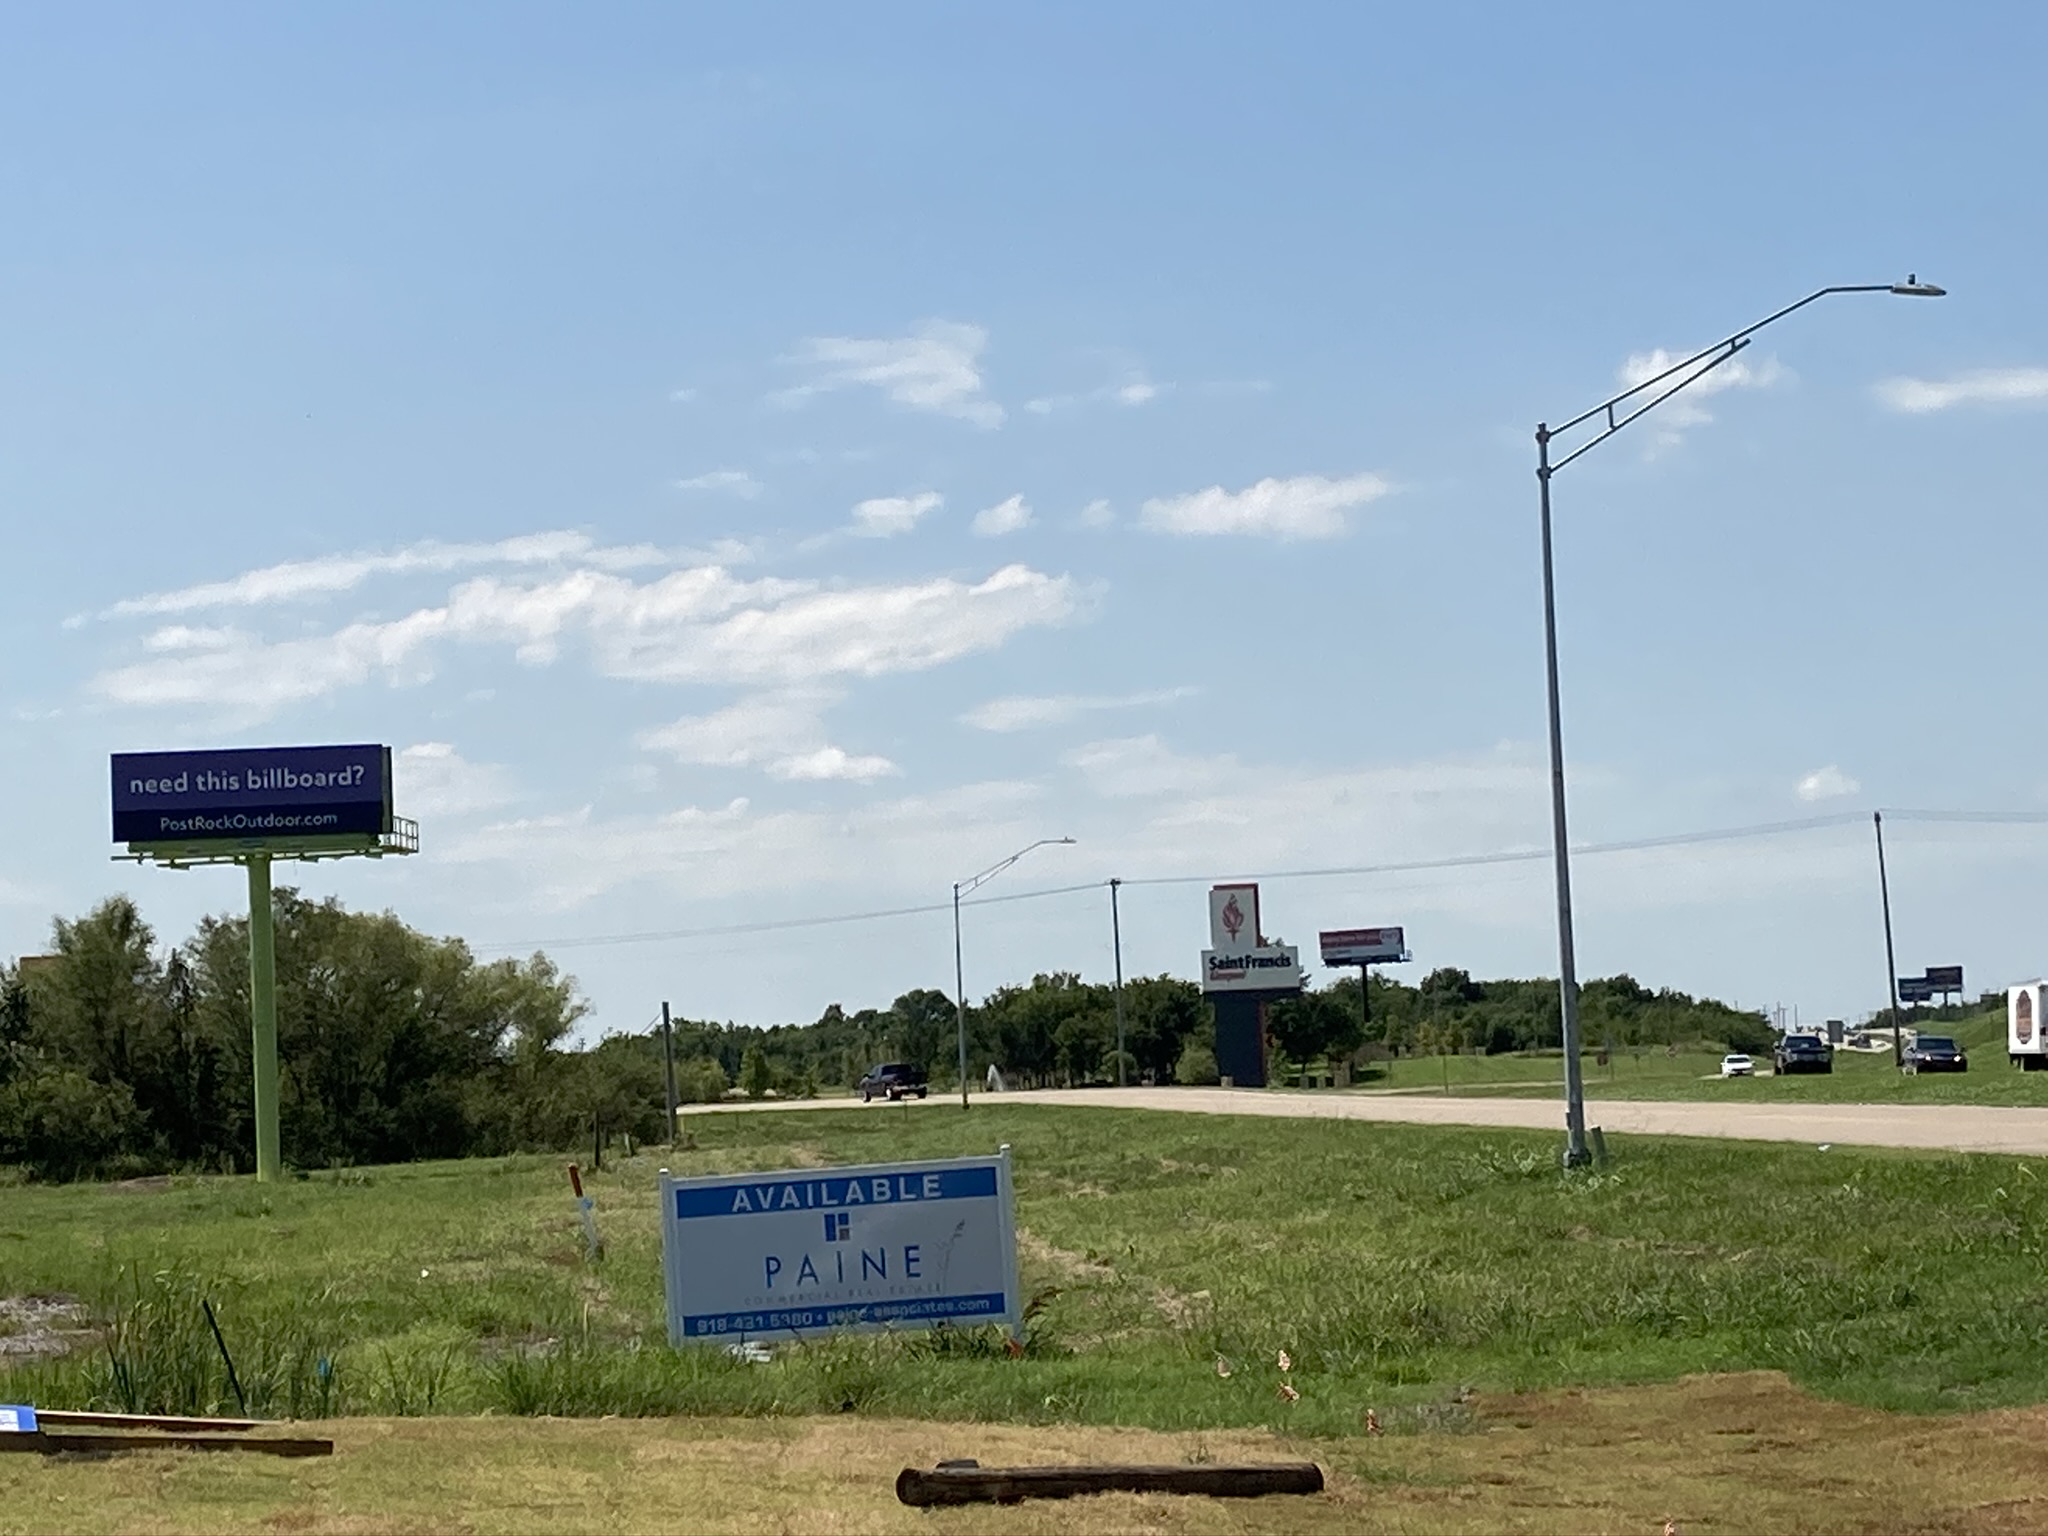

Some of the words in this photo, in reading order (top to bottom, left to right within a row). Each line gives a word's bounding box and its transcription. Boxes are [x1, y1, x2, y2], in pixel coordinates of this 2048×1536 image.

[130, 772, 188, 794] need
[195, 769, 240, 792] this
[247, 764, 365, 790] billboard?
[160, 813, 338, 831] PostRockOutdoor.com
[731, 1174, 944, 1213] AVAILABLE
[765, 1245, 922, 1289] PAINE
